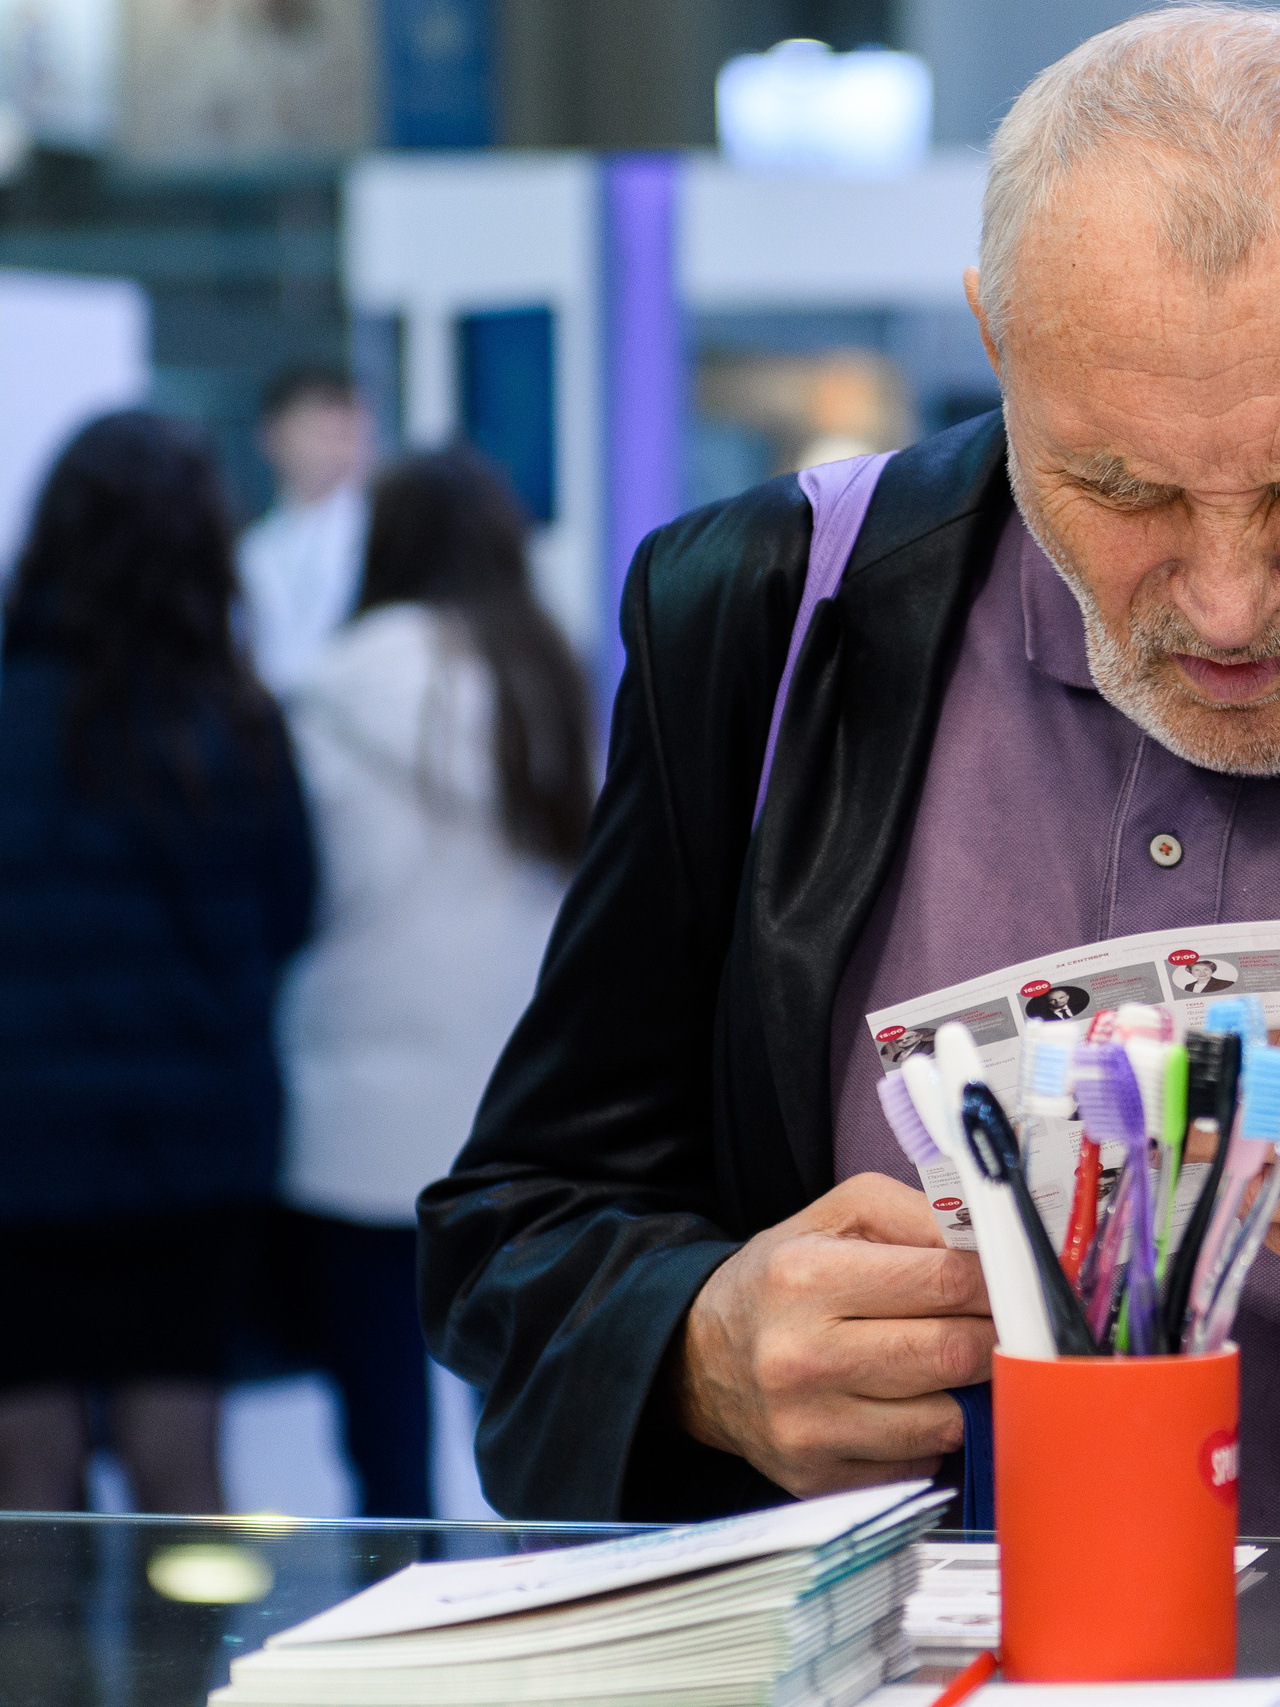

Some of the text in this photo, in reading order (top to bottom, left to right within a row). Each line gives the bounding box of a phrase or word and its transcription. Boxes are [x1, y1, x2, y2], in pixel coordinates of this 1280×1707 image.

[1067, 952, 1110, 966] СЕНТЯБРЯ
[1171, 953, 1197, 961] 17:00
[1023, 983, 1049, 994] 16:00
[878, 1028, 904, 1040] 15:00
[935, 1200, 961, 1208] 14:00
